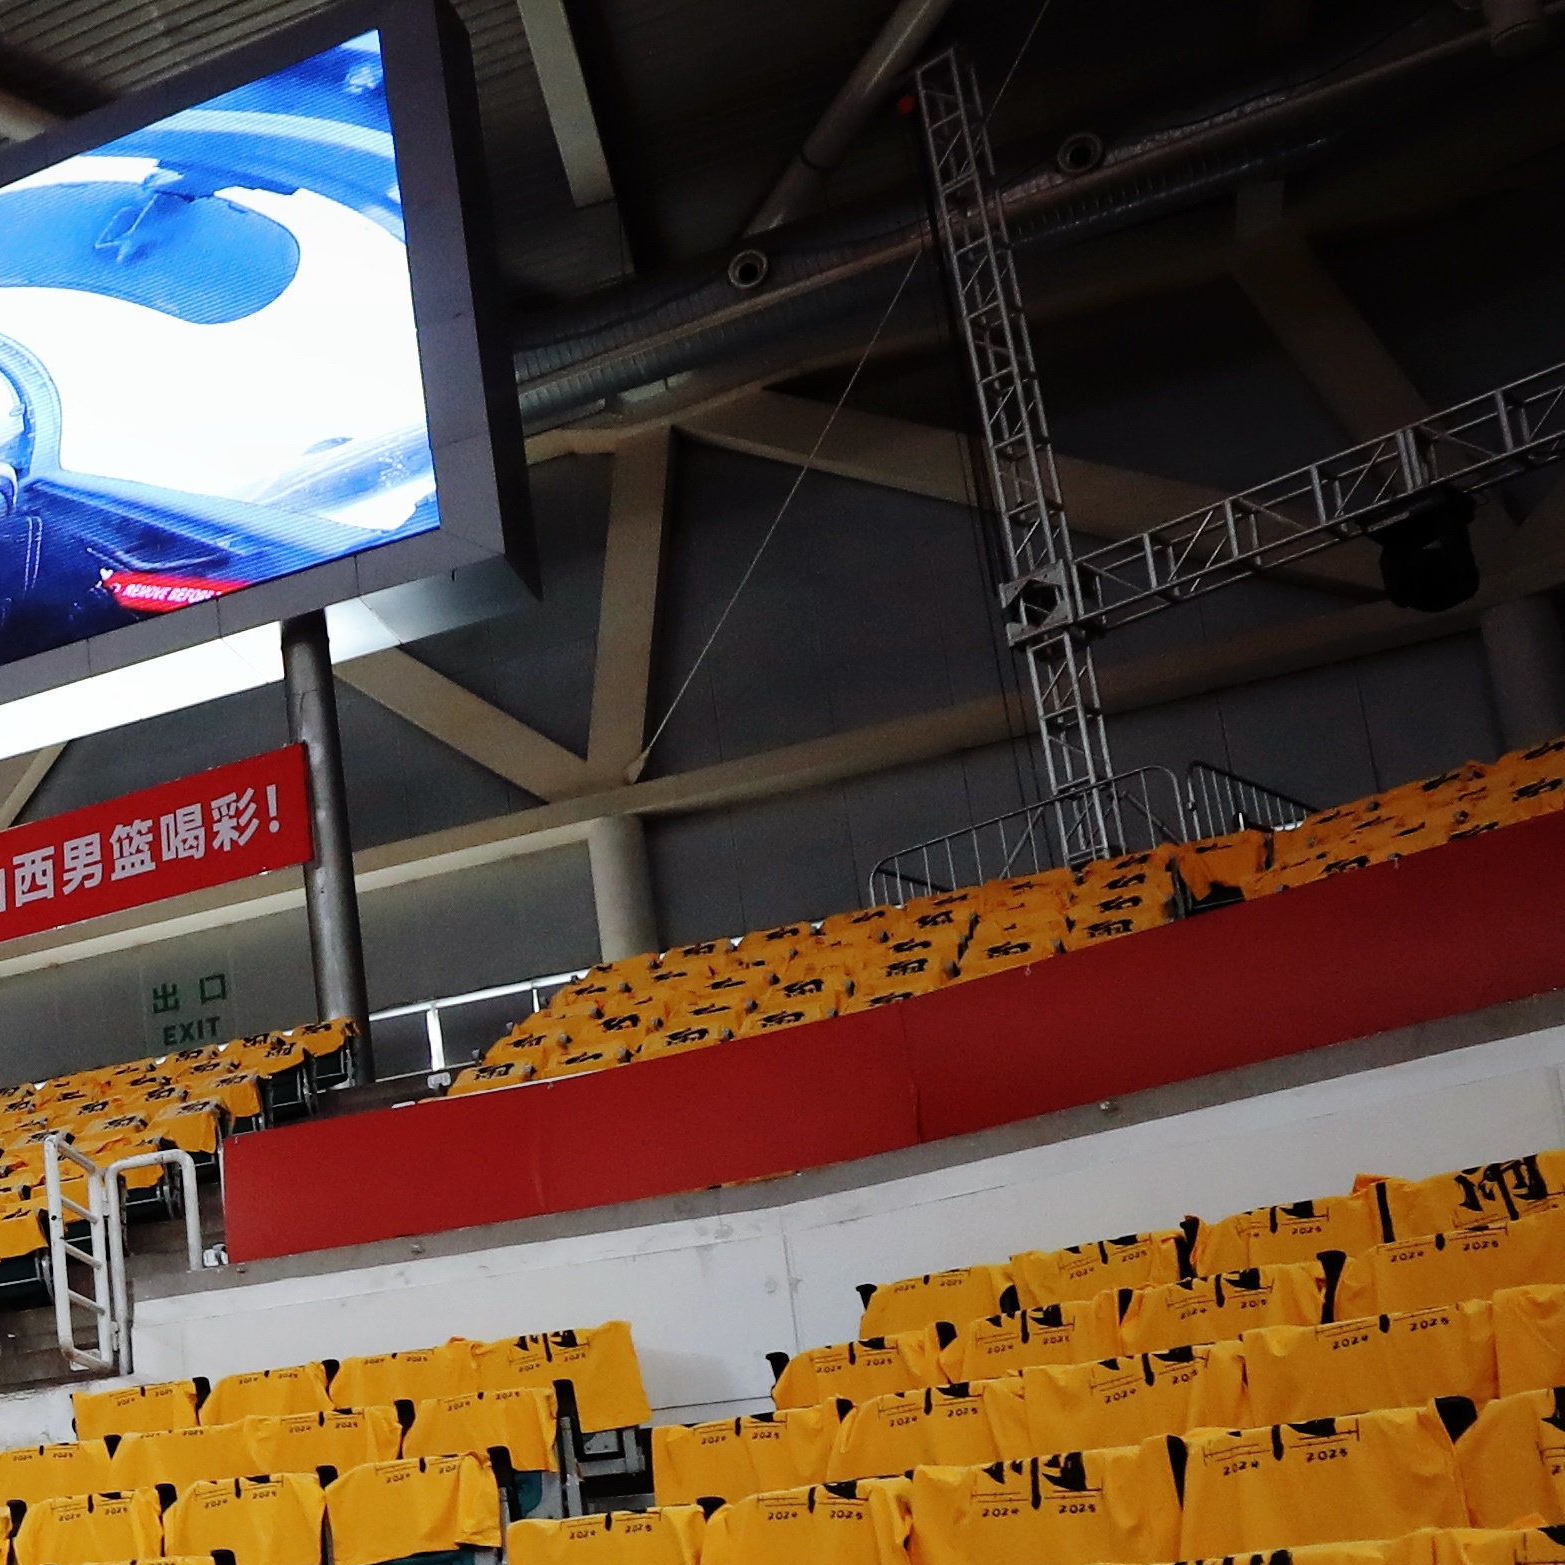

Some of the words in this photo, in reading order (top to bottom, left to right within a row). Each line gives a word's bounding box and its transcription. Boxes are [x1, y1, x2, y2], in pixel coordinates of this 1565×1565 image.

[153, 973, 227, 1013] 出口
[163, 1016, 220, 1046] EXIT
[1463, 1239, 1499, 1251] 2025
[1409, 1317, 1449, 1331] 2025
[1306, 1448, 1348, 1463] 2025
[768, 1510, 798, 1520] 2024
[830, 1509, 863, 1520] 2025
[982, 1508, 1019, 1517] 2024
[1059, 1504, 1096, 1514] 2025
